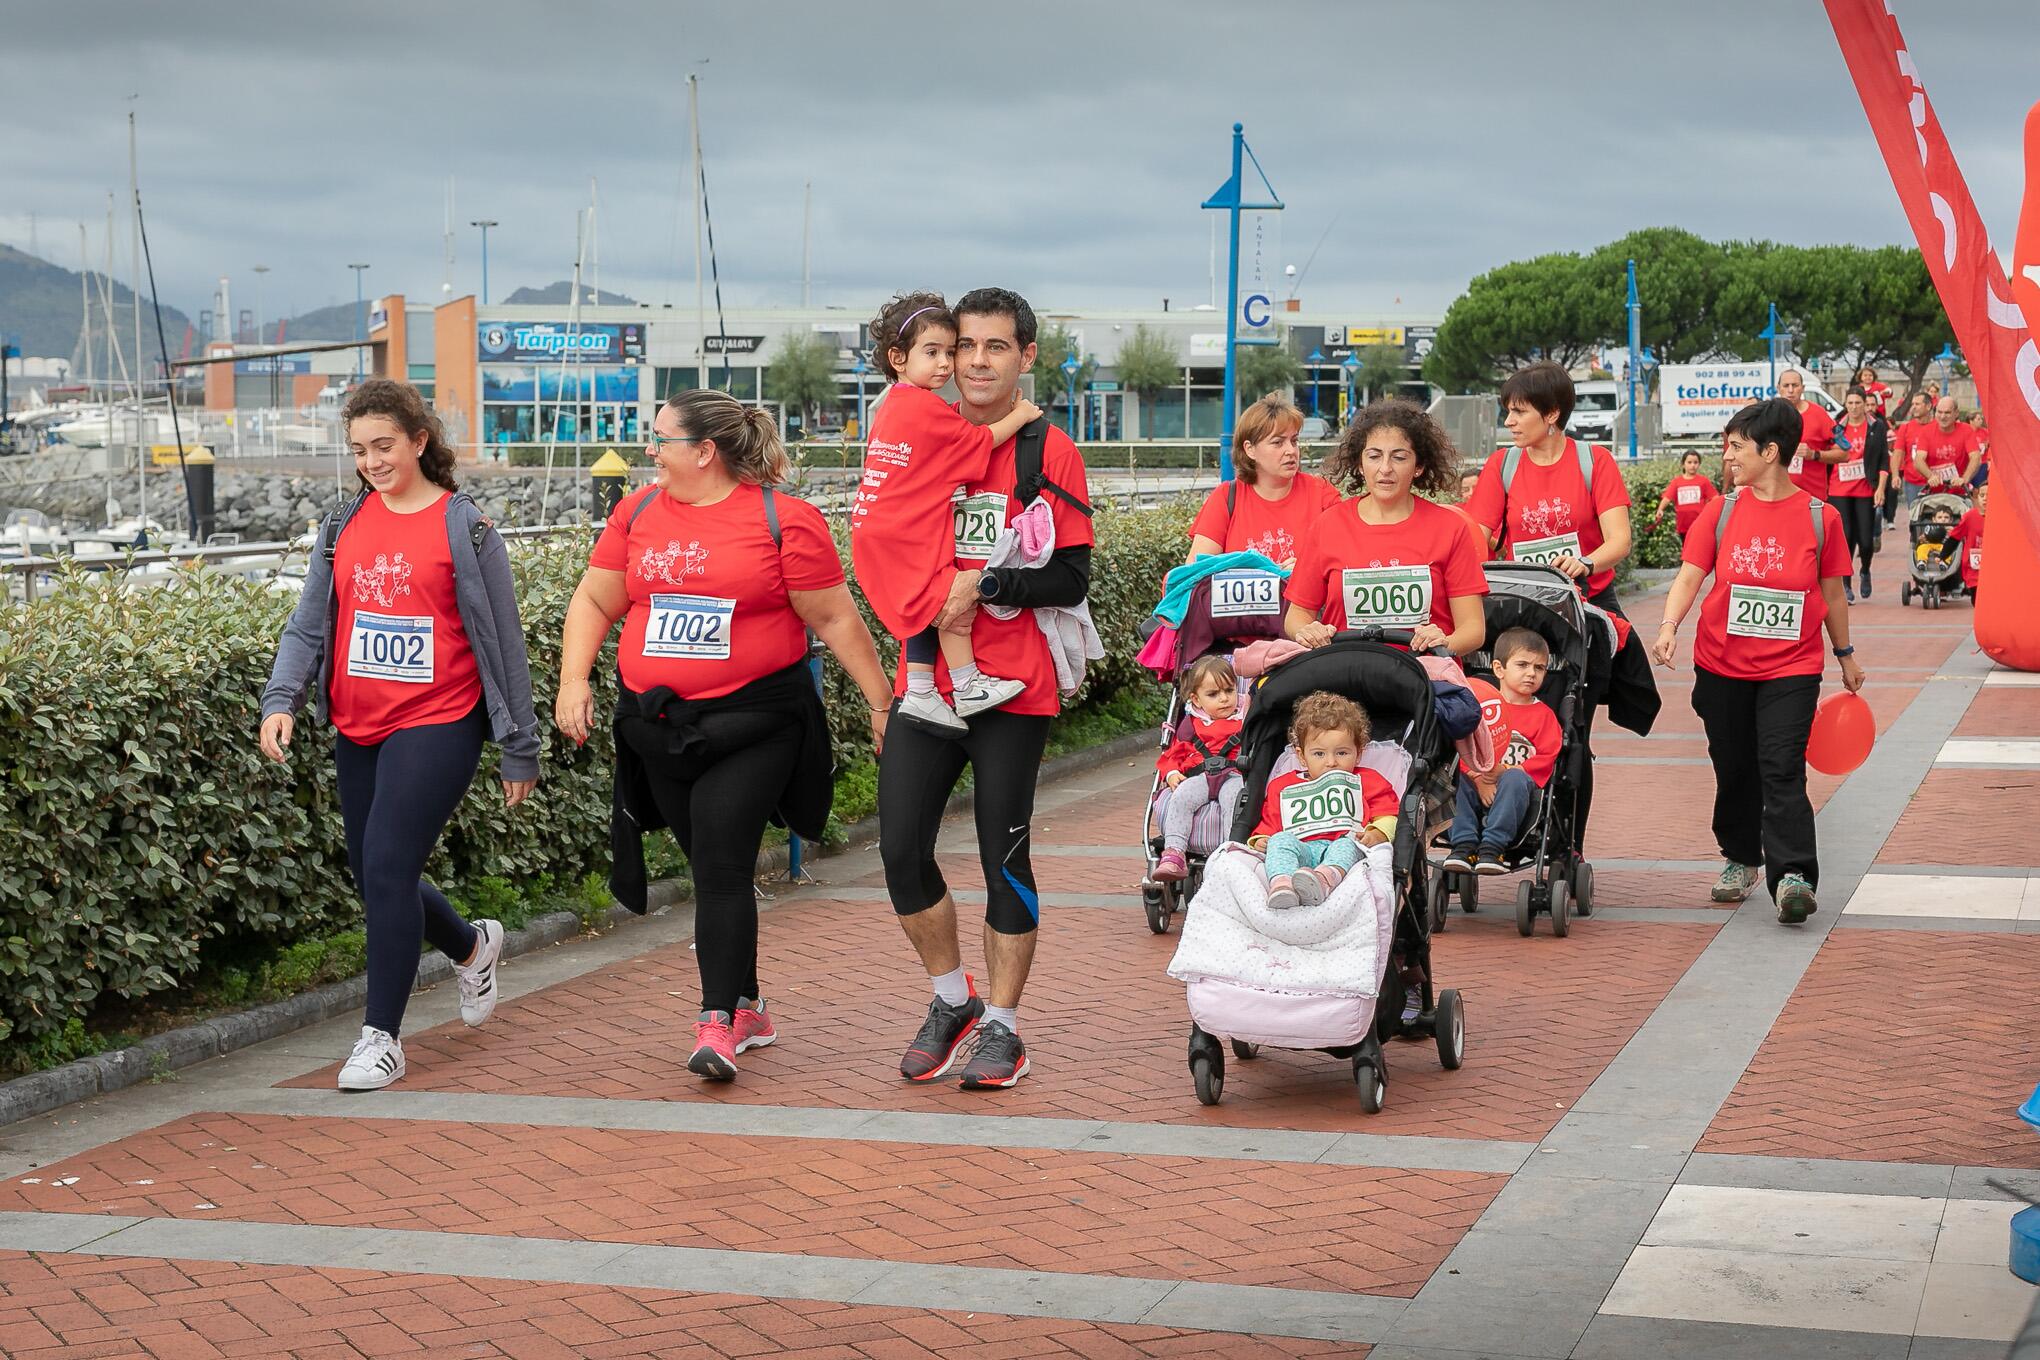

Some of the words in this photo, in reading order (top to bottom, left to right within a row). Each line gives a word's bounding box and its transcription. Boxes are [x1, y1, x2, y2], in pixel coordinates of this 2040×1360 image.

[1255, 215, 1264, 281] PANTALAN
[1243, 294, 1271, 328] C
[514, 329, 611, 355] Tarpoon
[1677, 383, 1777, 400] telefurgo
[1681, 408, 1716, 418] alquiler
[1220, 580, 1272, 603] 1013
[1353, 583, 1424, 615] 2060
[658, 611, 721, 642] 1002
[1736, 600, 1795, 628] 2034
[359, 631, 425, 666] 1002
[1290, 787, 1356, 825] 2060
